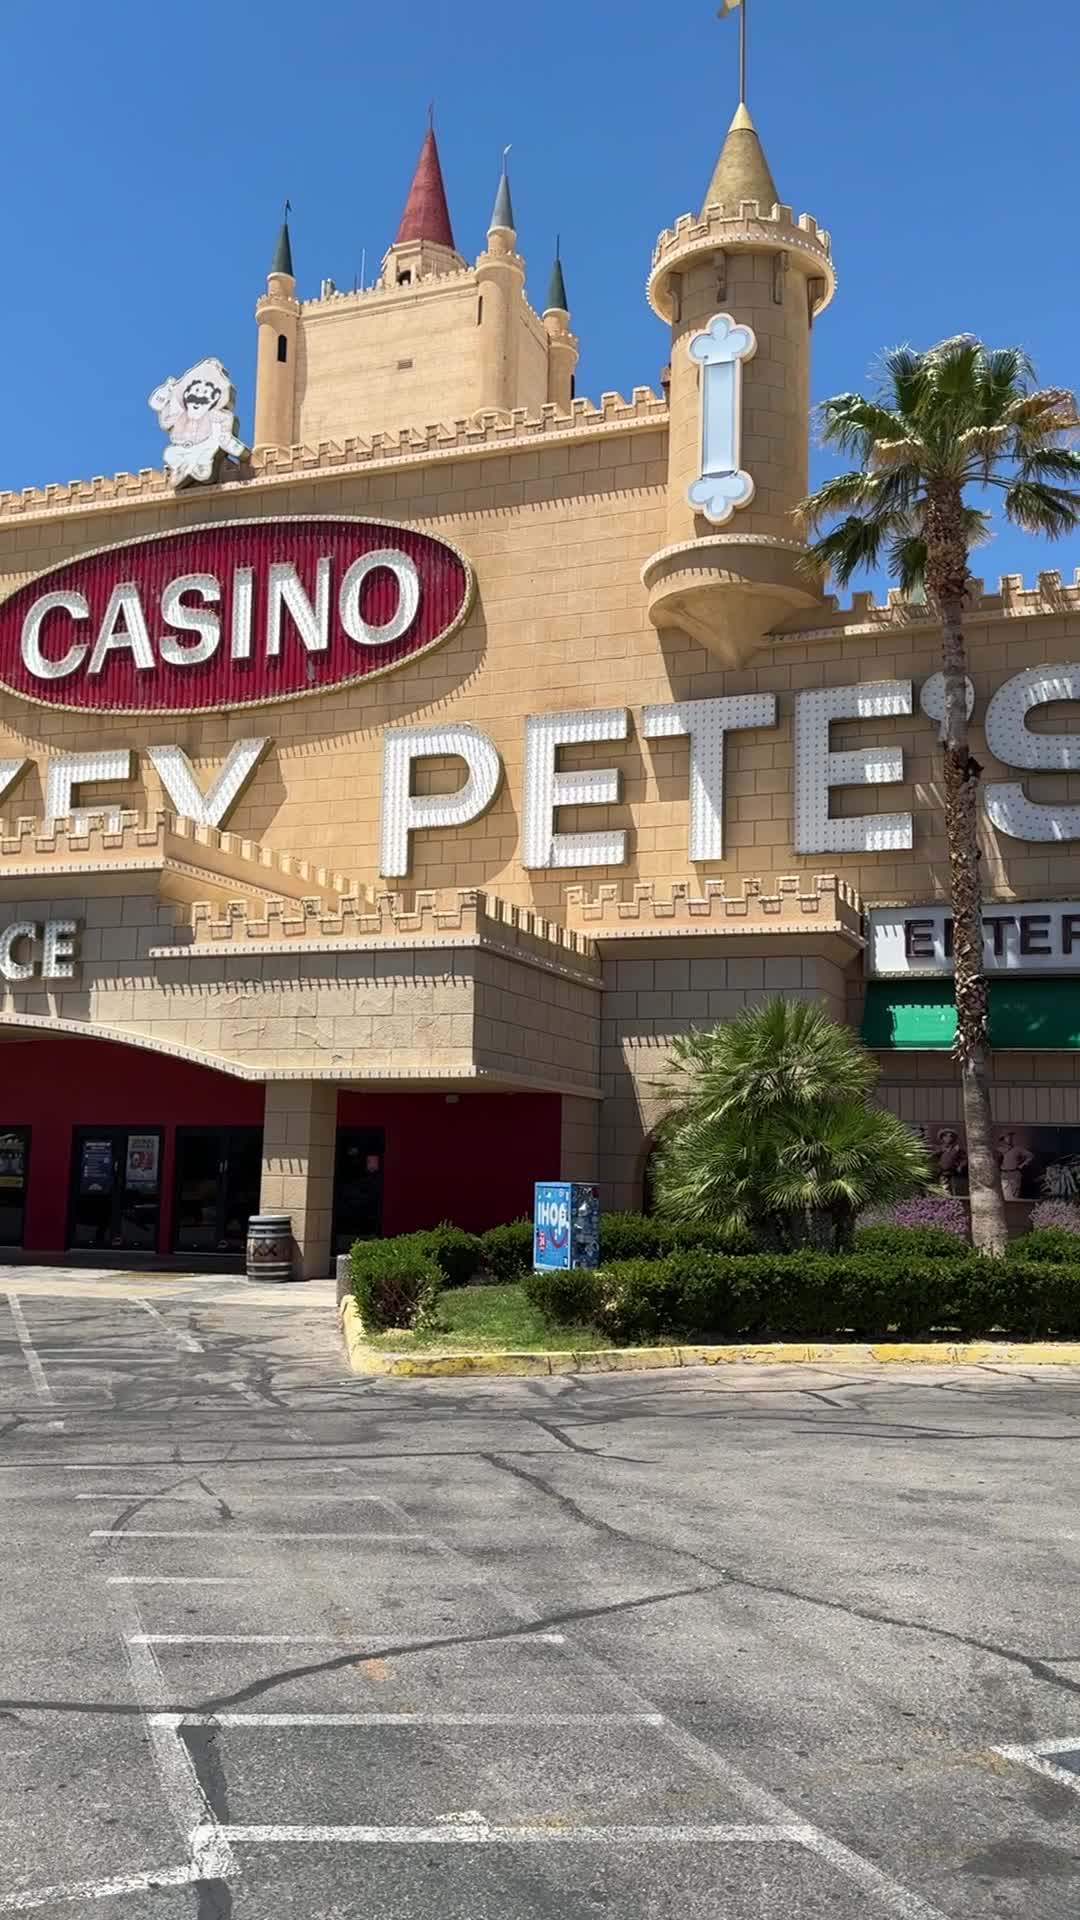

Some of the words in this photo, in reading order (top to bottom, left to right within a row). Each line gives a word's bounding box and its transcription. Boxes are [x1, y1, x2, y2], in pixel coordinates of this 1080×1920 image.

[21, 548, 420, 680] CASINO
[0, 736, 275, 836] EY
[905, 914, 1080, 958] ETER
